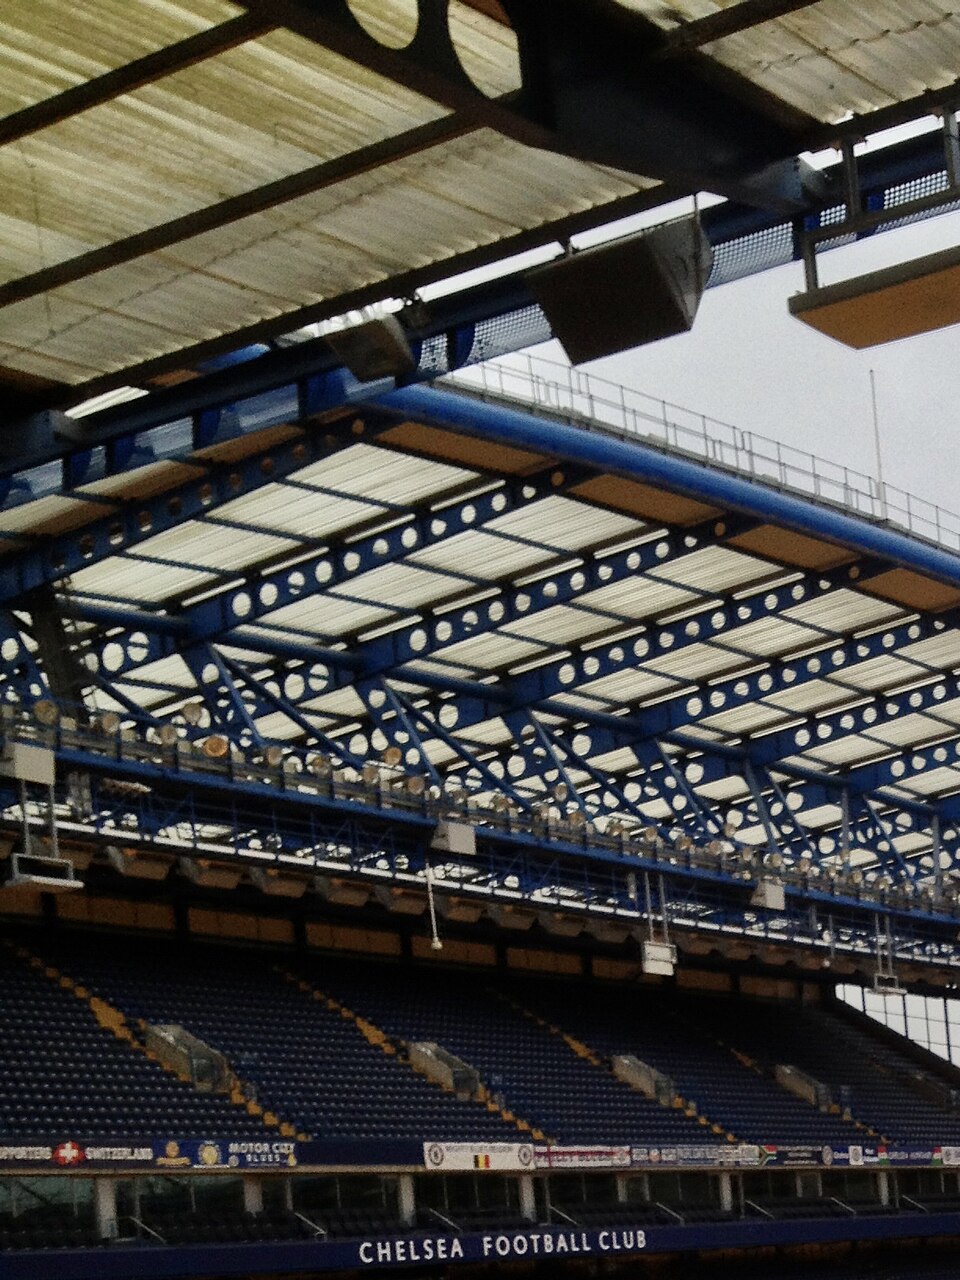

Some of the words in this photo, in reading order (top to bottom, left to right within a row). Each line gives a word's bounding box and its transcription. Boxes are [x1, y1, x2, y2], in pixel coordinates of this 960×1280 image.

[358, 1238, 464, 1264] CHELSEA
[482, 1232, 592, 1257] FOOTBALL
[598, 1229, 647, 1250] CLUB
